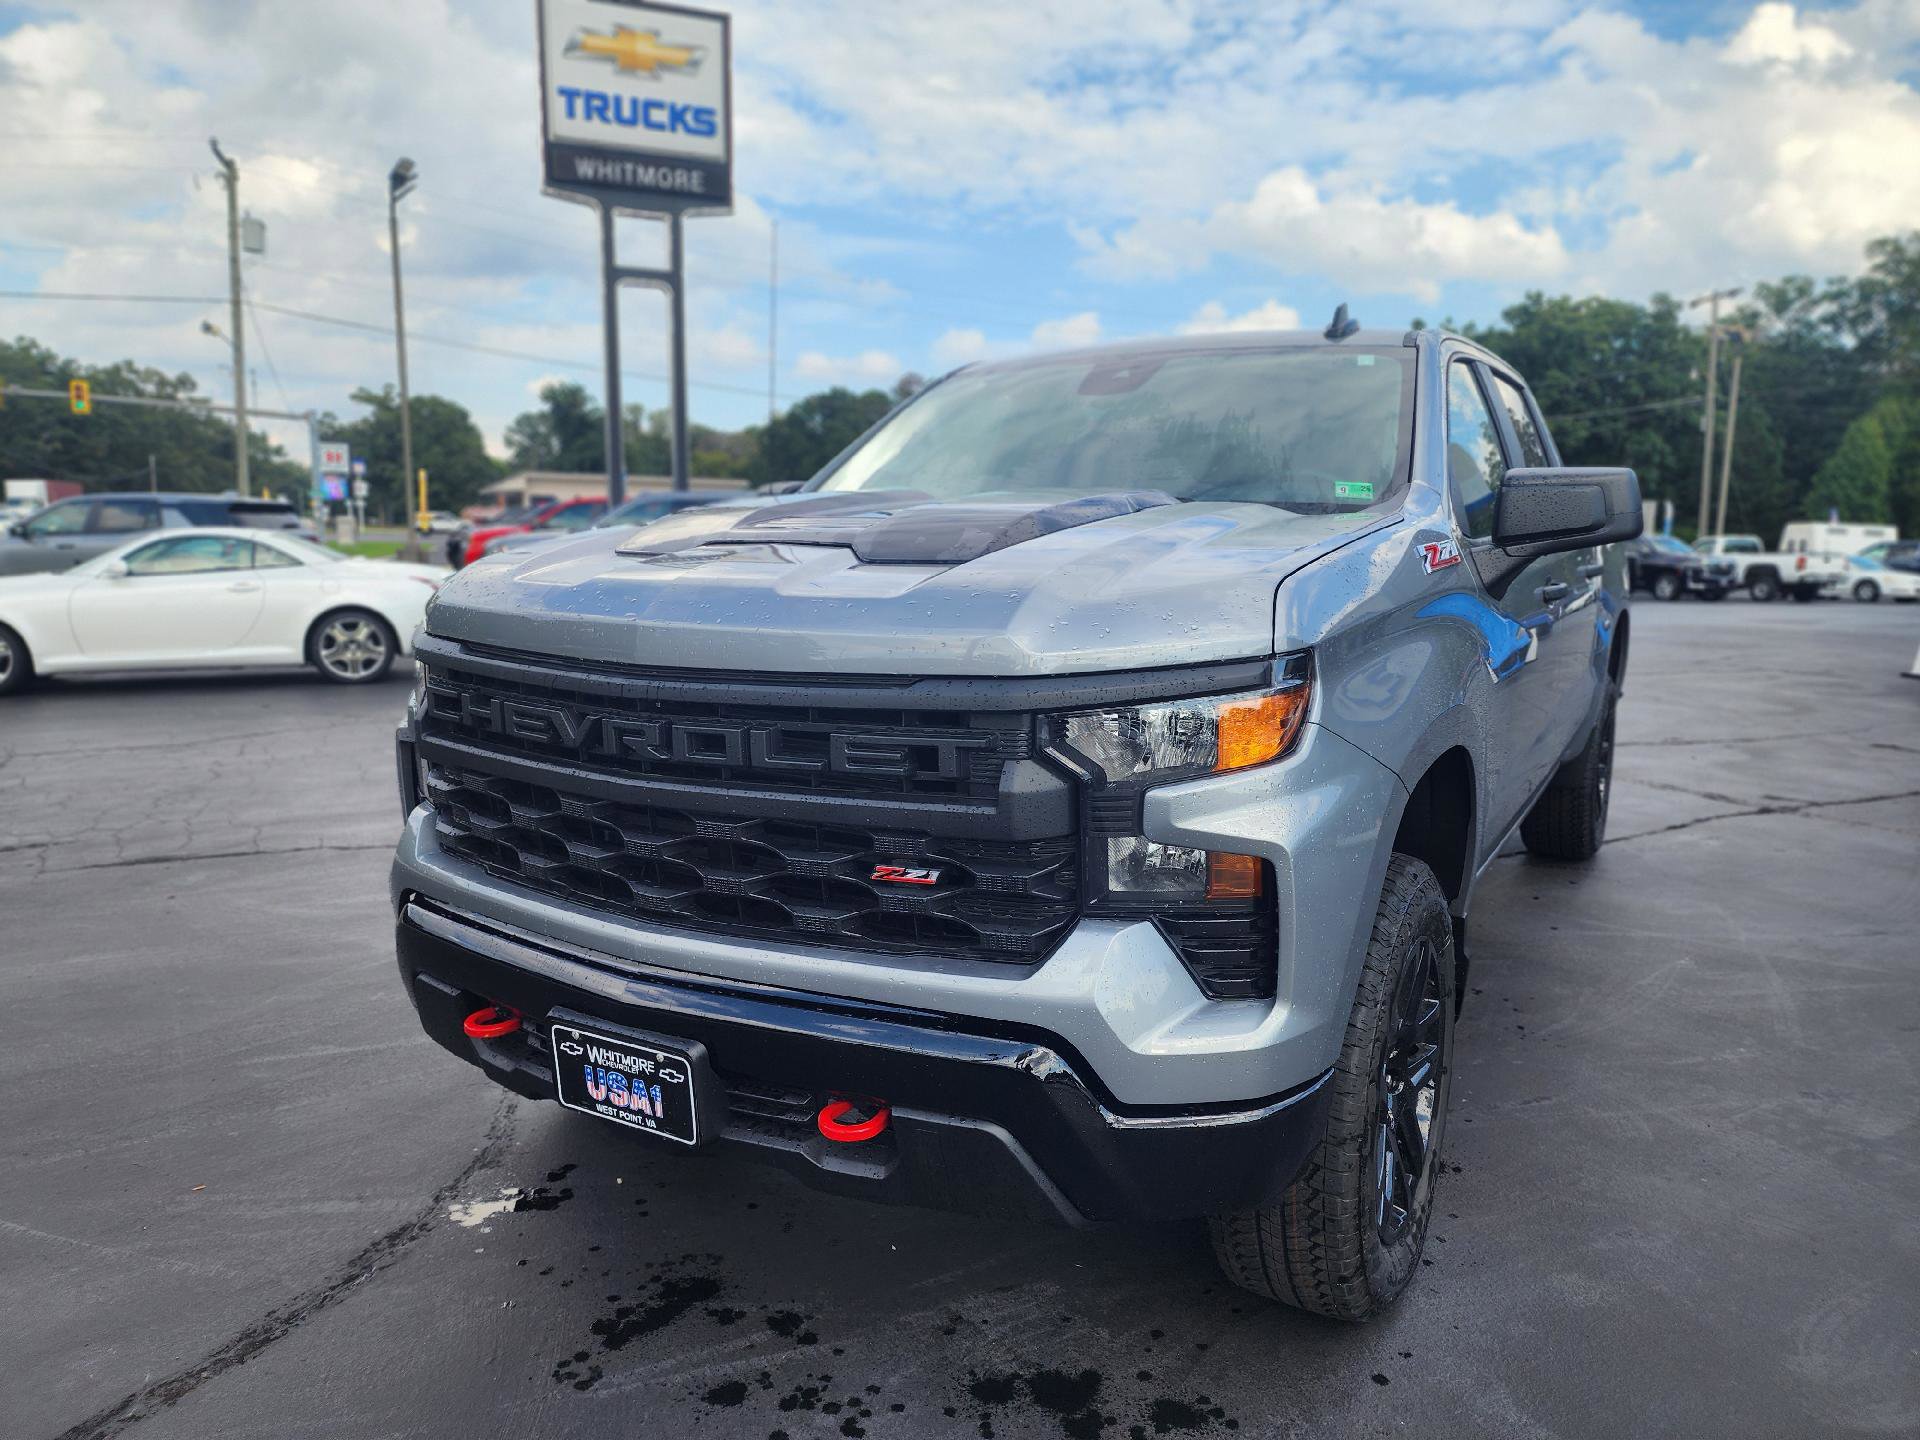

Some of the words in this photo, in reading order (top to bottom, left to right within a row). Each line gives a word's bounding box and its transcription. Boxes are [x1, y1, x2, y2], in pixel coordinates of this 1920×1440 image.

[557, 85, 717, 138] TRUCKS
[574, 156, 705, 192] WHITMORE
[1416, 540, 1461, 576] Z71
[425, 682, 999, 778] CHEVROLET
[870, 865, 941, 885] Z71
[586, 1044, 655, 1075] WHITMORE
[601, 1059, 640, 1075] CHEVROLET
[596, 1103, 618, 1117] WEST
[645, 1118, 657, 1129] VA
